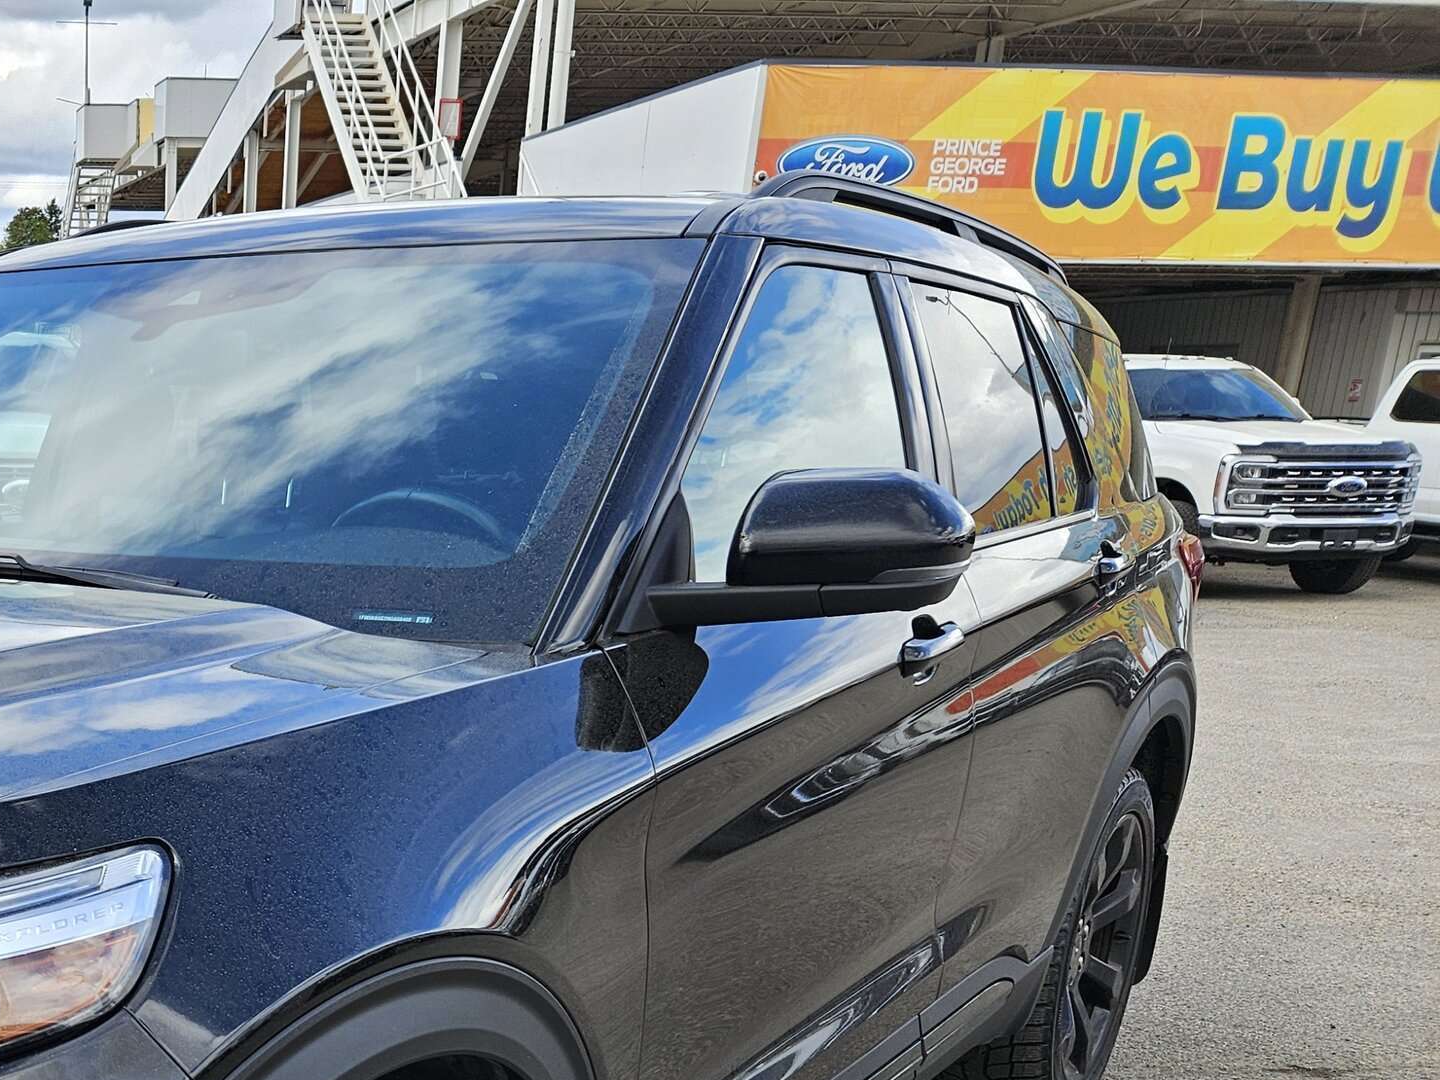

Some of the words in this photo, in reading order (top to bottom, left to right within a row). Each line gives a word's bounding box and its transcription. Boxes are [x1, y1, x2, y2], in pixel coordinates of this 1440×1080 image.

[932, 138, 1003, 157] PRINCE
[929, 157, 1008, 177] GEORGE
[1033, 108, 1193, 212] We
[1215, 113, 1406, 240] Buy
[926, 176, 979, 194] FORD
